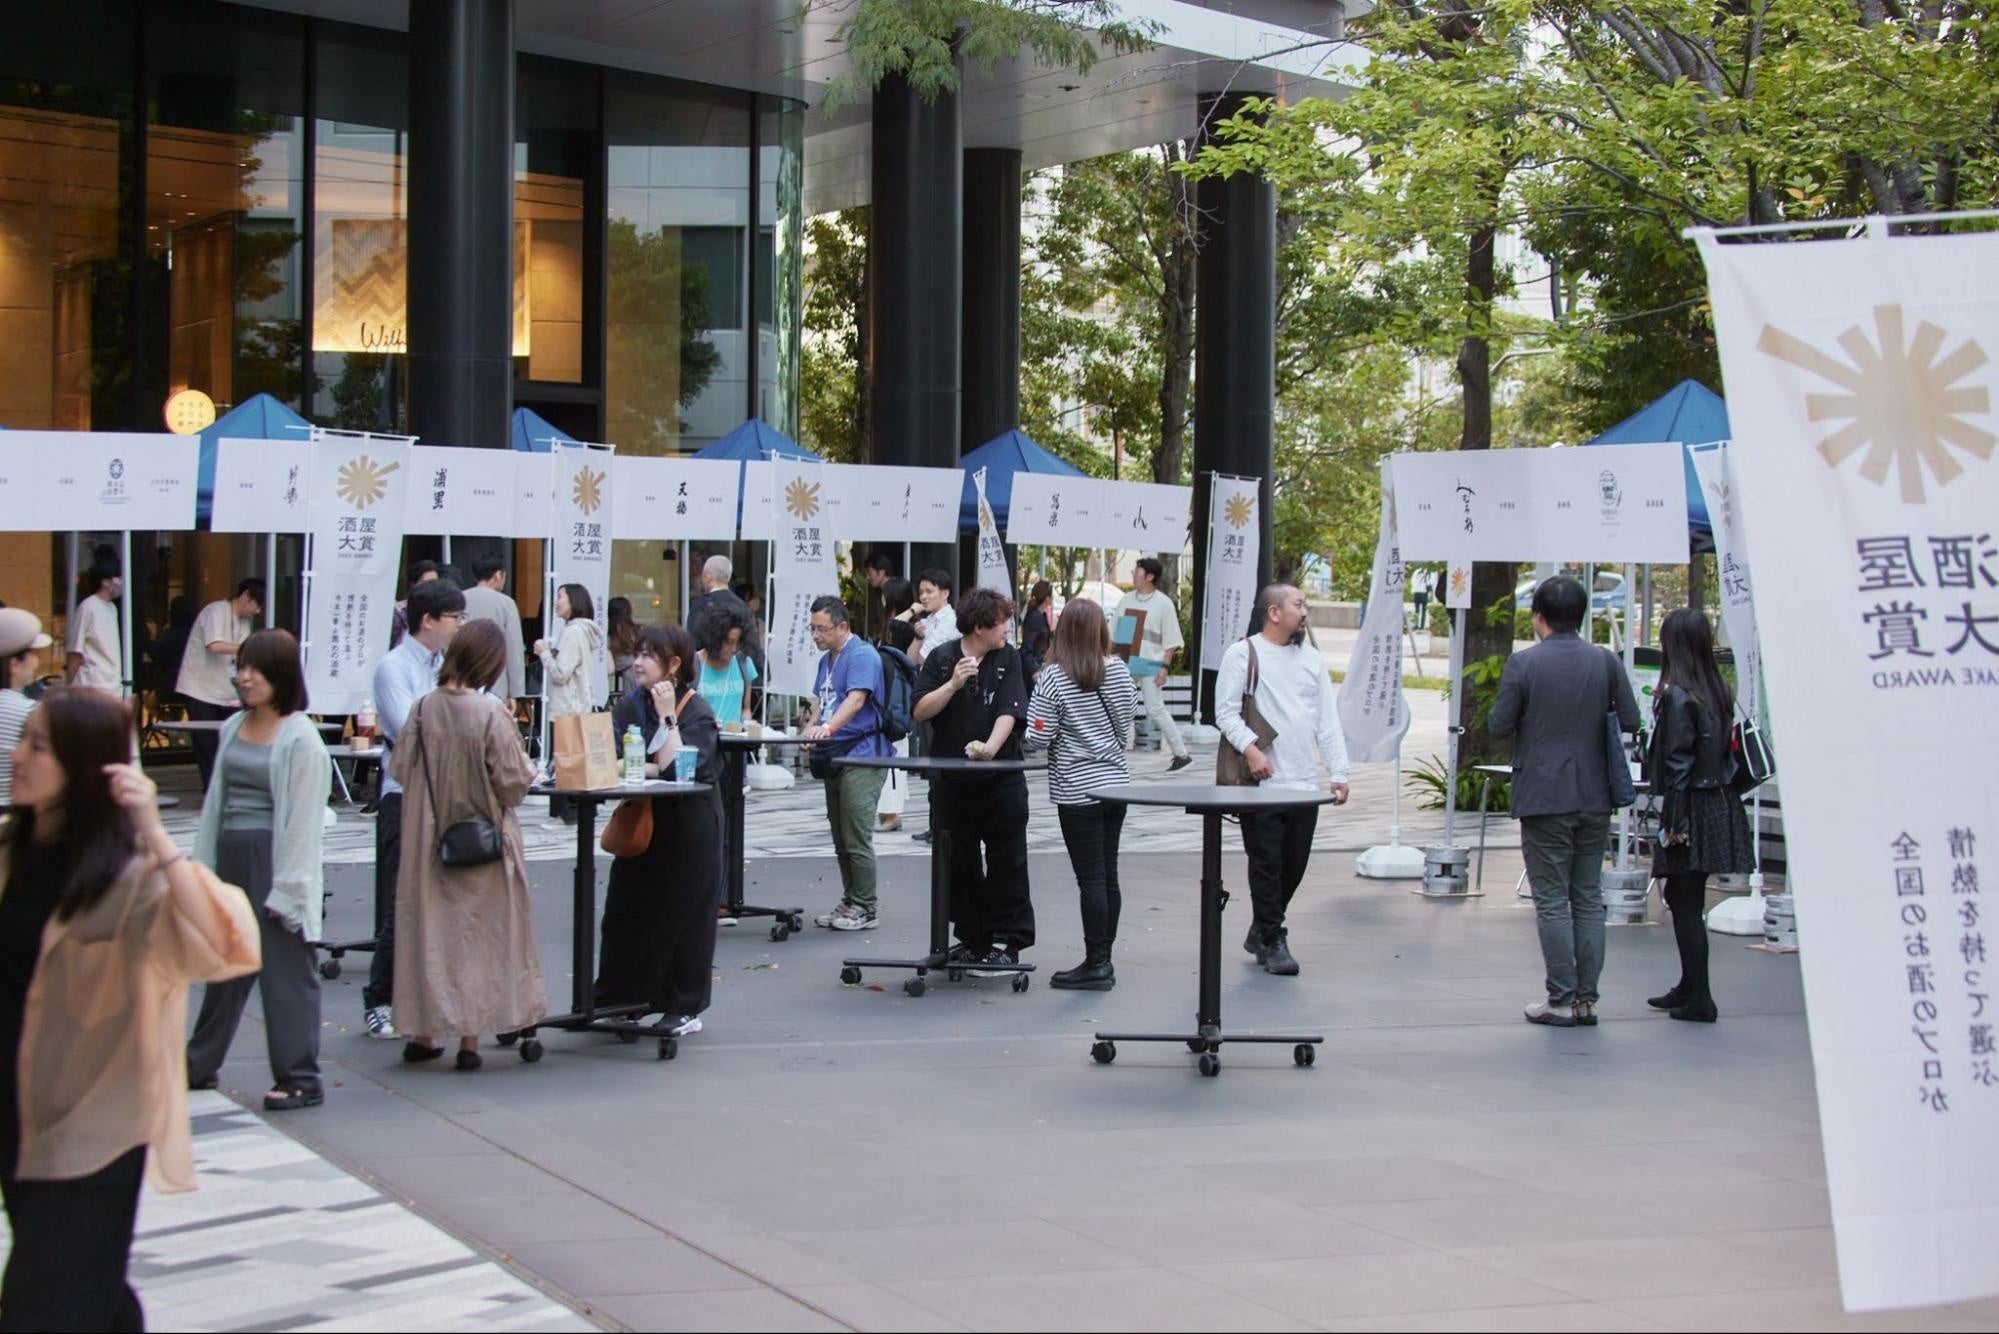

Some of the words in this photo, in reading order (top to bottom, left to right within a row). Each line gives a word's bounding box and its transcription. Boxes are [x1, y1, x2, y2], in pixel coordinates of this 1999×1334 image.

[338, 516, 377, 533] 酒屋
[573, 522, 602, 538] 酒屋
[792, 527, 821, 541] 酒屋
[1224, 534, 1245, 546] 酒屋
[338, 535, 375, 551] 大賞
[573, 539, 602, 555] 大賞
[795, 542, 822, 557] 大賞
